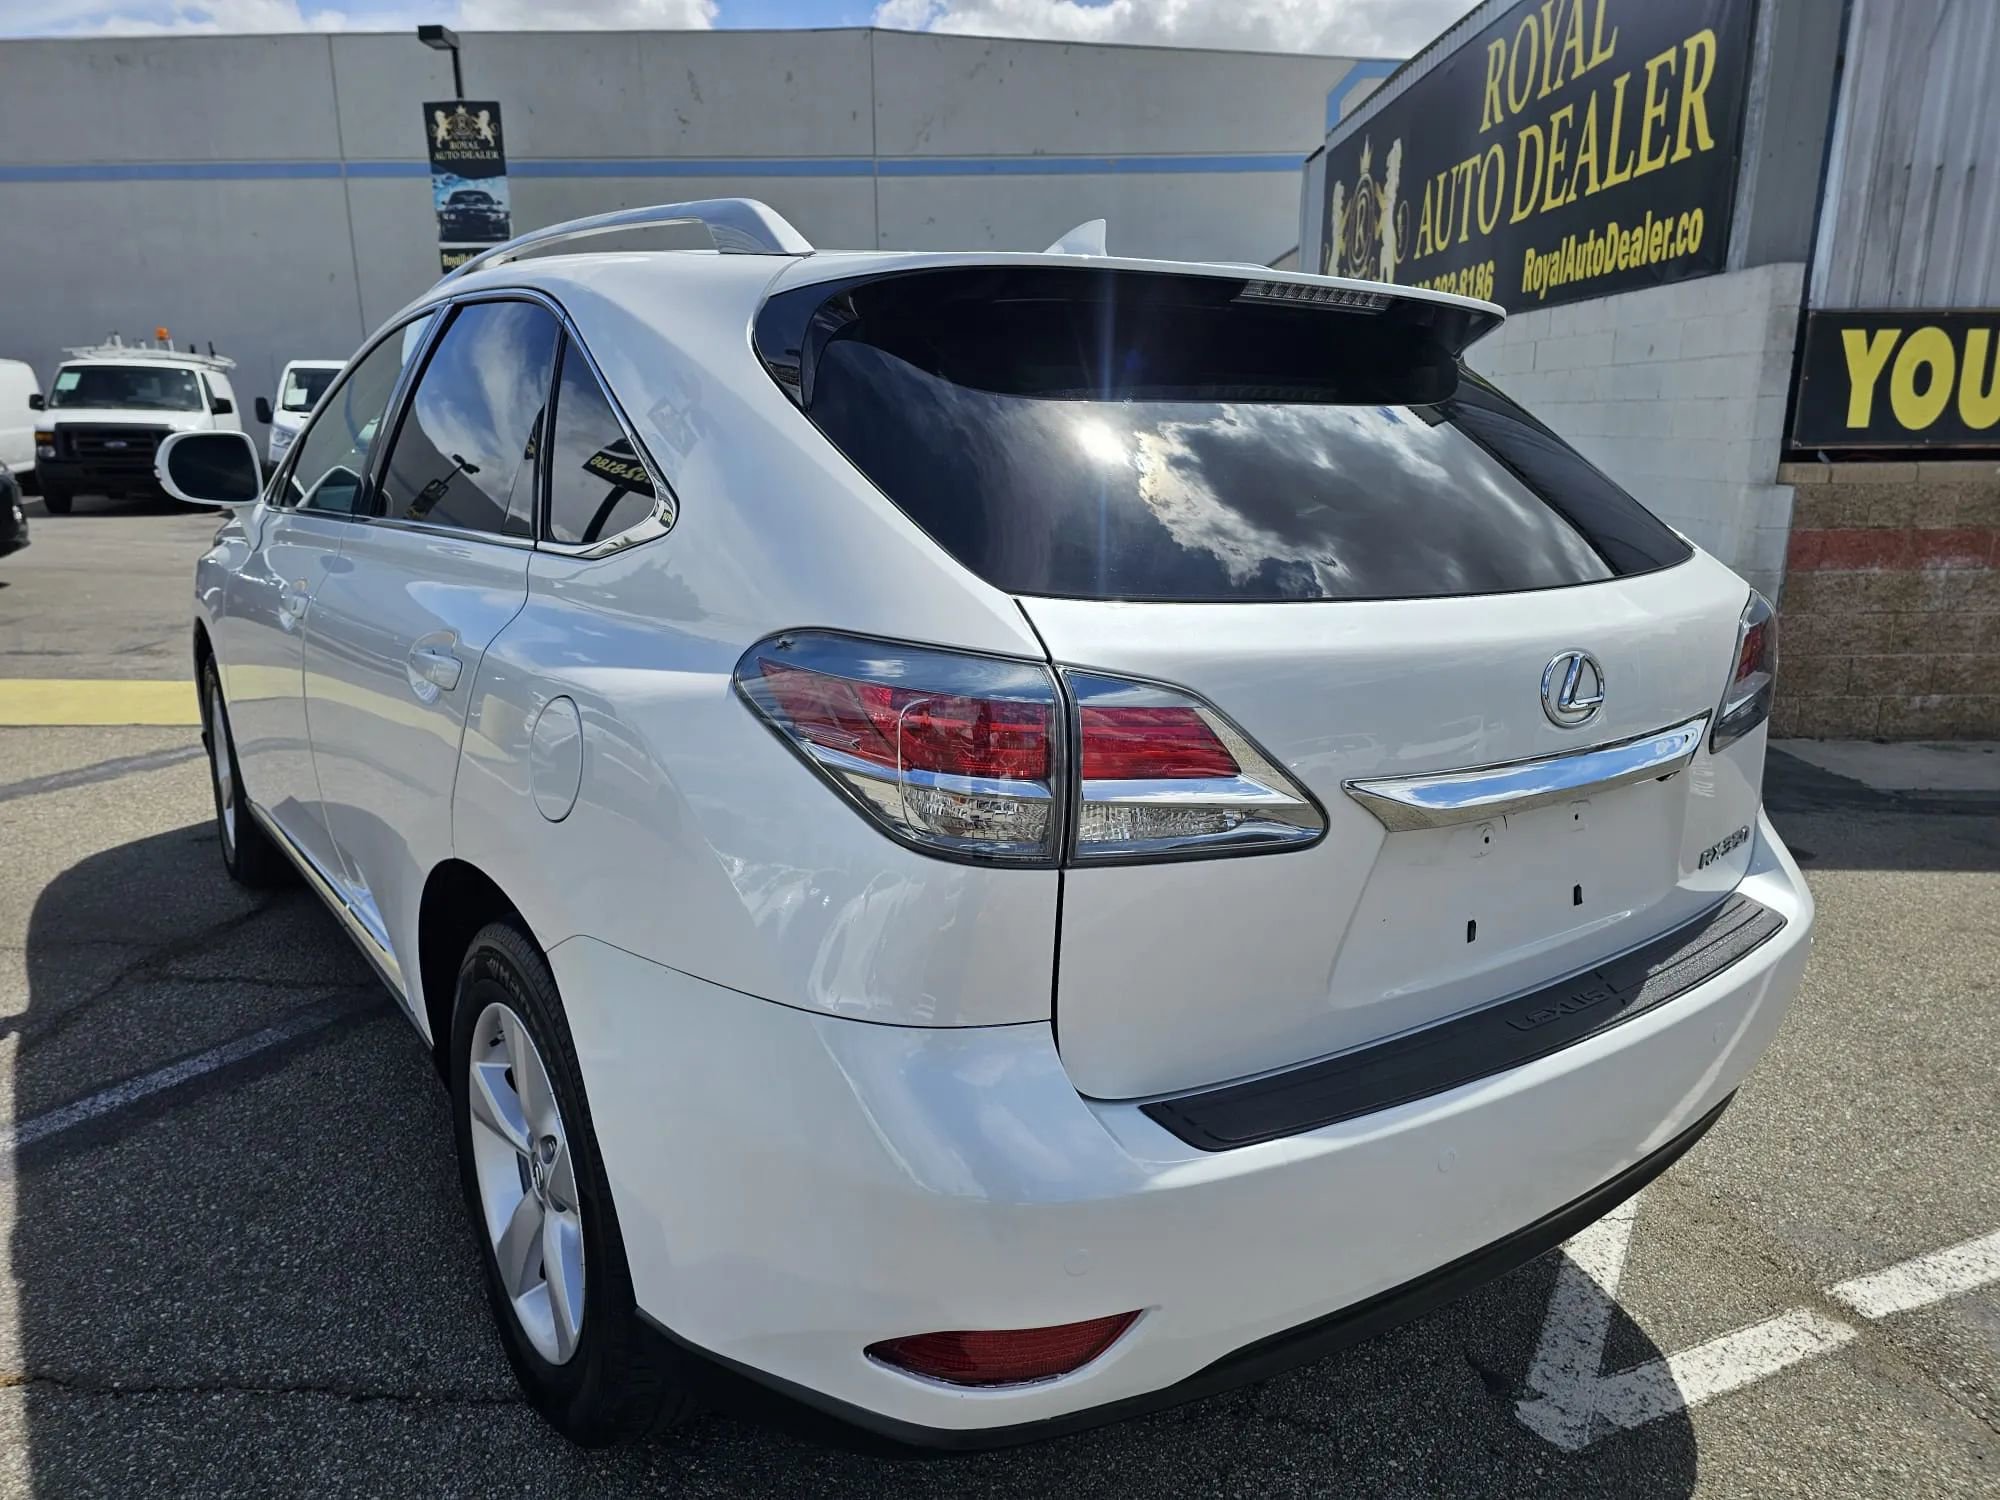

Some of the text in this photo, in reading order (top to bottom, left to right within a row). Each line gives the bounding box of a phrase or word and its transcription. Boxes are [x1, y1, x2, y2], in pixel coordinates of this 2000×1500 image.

[1479, 0, 1619, 133] ROYAL
[434, 151, 499, 160] AUTO DEALER
[1413, 28, 1717, 260] AUTO DEALER
[1521, 208, 1704, 300] RoyalAutoDealer.co
[1841, 326, 2000, 430] YOU
[1505, 989, 1606, 1031] LEXUS
